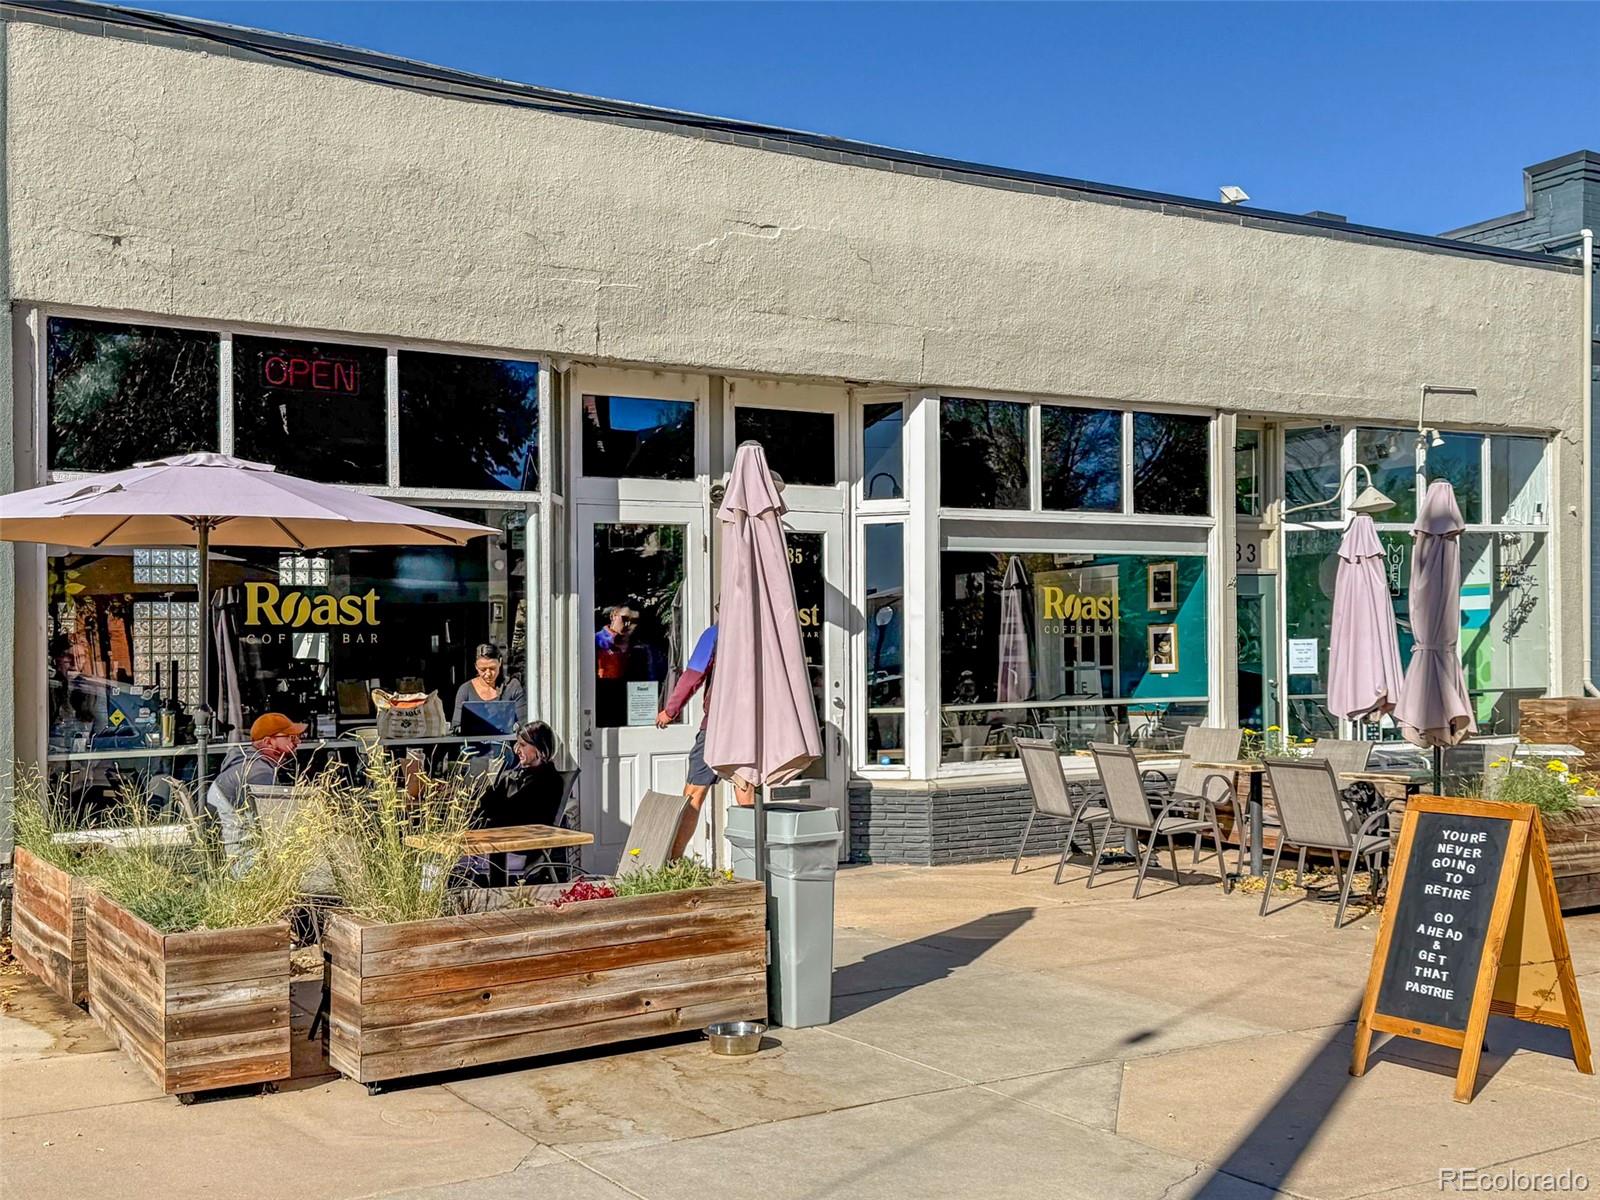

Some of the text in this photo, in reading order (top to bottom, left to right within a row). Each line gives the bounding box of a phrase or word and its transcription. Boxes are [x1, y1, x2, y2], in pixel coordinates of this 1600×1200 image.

[265, 356, 354, 391] OPEN
[1392, 554, 1400, 590] OPEN
[244, 582, 381, 628] Roast
[1043, 586, 1121, 621] Roast
[1044, 625, 1092, 634] COFFEE
[246, 633, 378, 644] COFEE BAR
[1442, 830, 1488, 844] YOURE
[1437, 843, 1482, 858] NEVER
[1432, 857, 1476, 874] GOING
[1445, 872, 1463, 884] TO
[1424, 884, 1472, 900] RETIRE
[1434, 912, 1454, 924] GO
[1416, 923, 1463, 941] AHEAD
[1432, 940, 1441, 950] &
[1418, 950, 1447, 965] GET
[1414, 966, 1449, 981] THAT
[1405, 981, 1455, 1000] PASTRIE
